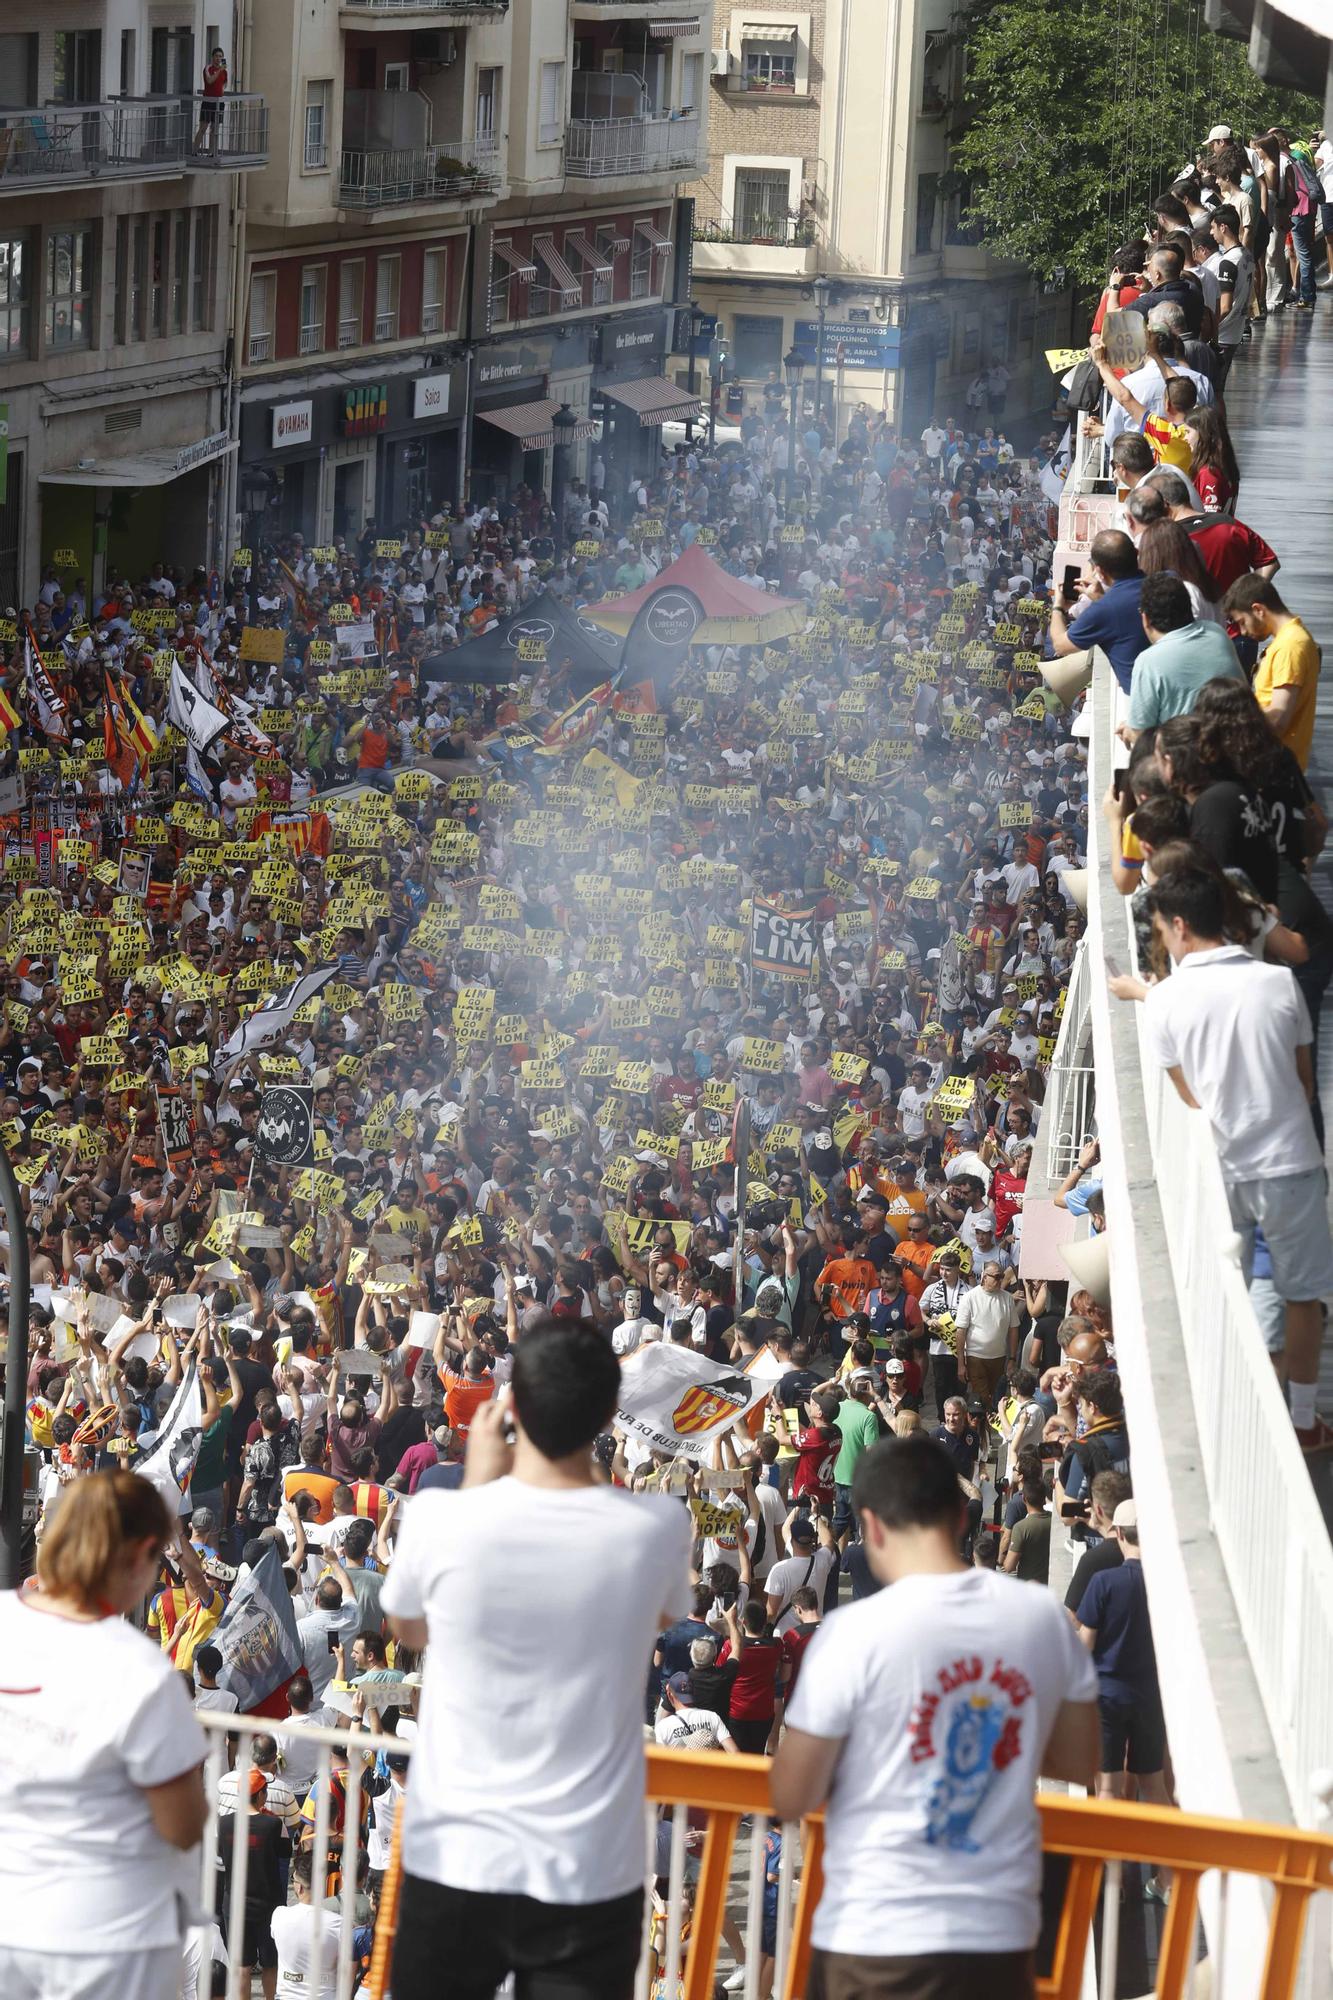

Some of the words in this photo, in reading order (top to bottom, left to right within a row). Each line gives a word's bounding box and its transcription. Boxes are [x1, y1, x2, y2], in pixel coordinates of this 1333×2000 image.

[424, 388, 441, 406] Saica
[285, 412, 309, 434] YAMAHA
[524, 640, 541, 648] LIM
[959, 716, 978, 725] LIM
[952, 728, 979, 738] HOME
[63, 772, 89, 780] HOME
[848, 772, 875, 781] HOME
[692, 786, 712, 794] LIM
[366, 794, 385, 802] LIM
[397, 792, 428, 800] HOME
[687, 800, 716, 808] HOME
[359, 808, 390, 817] HOME
[139, 819, 160, 828] LIM
[1002, 817, 1031, 825] HOME
[355, 823, 376, 831] LIM
[1272, 802, 1286, 853] 2
[135, 834, 166, 842] HOME
[350, 838, 381, 846] HOME
[66, 841, 86, 849] LIM
[197, 849, 217, 858] LIM
[224, 850, 257, 858] HOME
[12, 857, 30, 866] LIM
[61, 854, 92, 864] HOME
[191, 864, 222, 873] HOME
[6, 872, 36, 880] HOME
[915, 877, 933, 886] LIM
[907, 891, 937, 899] HOME
[120, 897, 138, 905] LIM
[332, 900, 353, 909] LIM
[431, 904, 452, 912] LIM
[114, 912, 144, 920] HOME
[327, 915, 359, 924] HOME
[754, 908, 812, 940] FCK
[118, 927, 140, 936] LIM
[471, 928, 493, 936] LIM
[114, 942, 148, 950] HOME
[465, 942, 499, 950] HOME
[753, 930, 812, 965] LIM
[67, 975, 89, 985] LIM
[708, 977, 736, 985] HOME
[64, 989, 100, 1003] HOME
[652, 988, 674, 999] LIM
[618, 1001, 640, 1009] LIM
[459, 1012, 482, 1021] LIM
[500, 1016, 522, 1025] LIM
[613, 1016, 649, 1026] HOME
[454, 1028, 488, 1038] HOME
[495, 1033, 529, 1042] HOME
[90, 1038, 112, 1047] LIM
[752, 1040, 776, 1050] LIM
[589, 1048, 609, 1056] LIM
[84, 1054, 121, 1063] HOME
[744, 1057, 780, 1069] HOME
[840, 1053, 861, 1065] LIM
[624, 1063, 646, 1073] LIM
[830, 1069, 863, 1083] HOME
[616, 1078, 648, 1091] HOME
[945, 1078, 966, 1088] LIM
[162, 1121, 190, 1148] LIM
[701, 1138, 720, 1151] LIM
[612, 1159, 628, 1170] LIM
[694, 1154, 725, 1169] HOME
[604, 1175, 628, 1190] HOME
[701, 1502, 733, 1518] LIM
